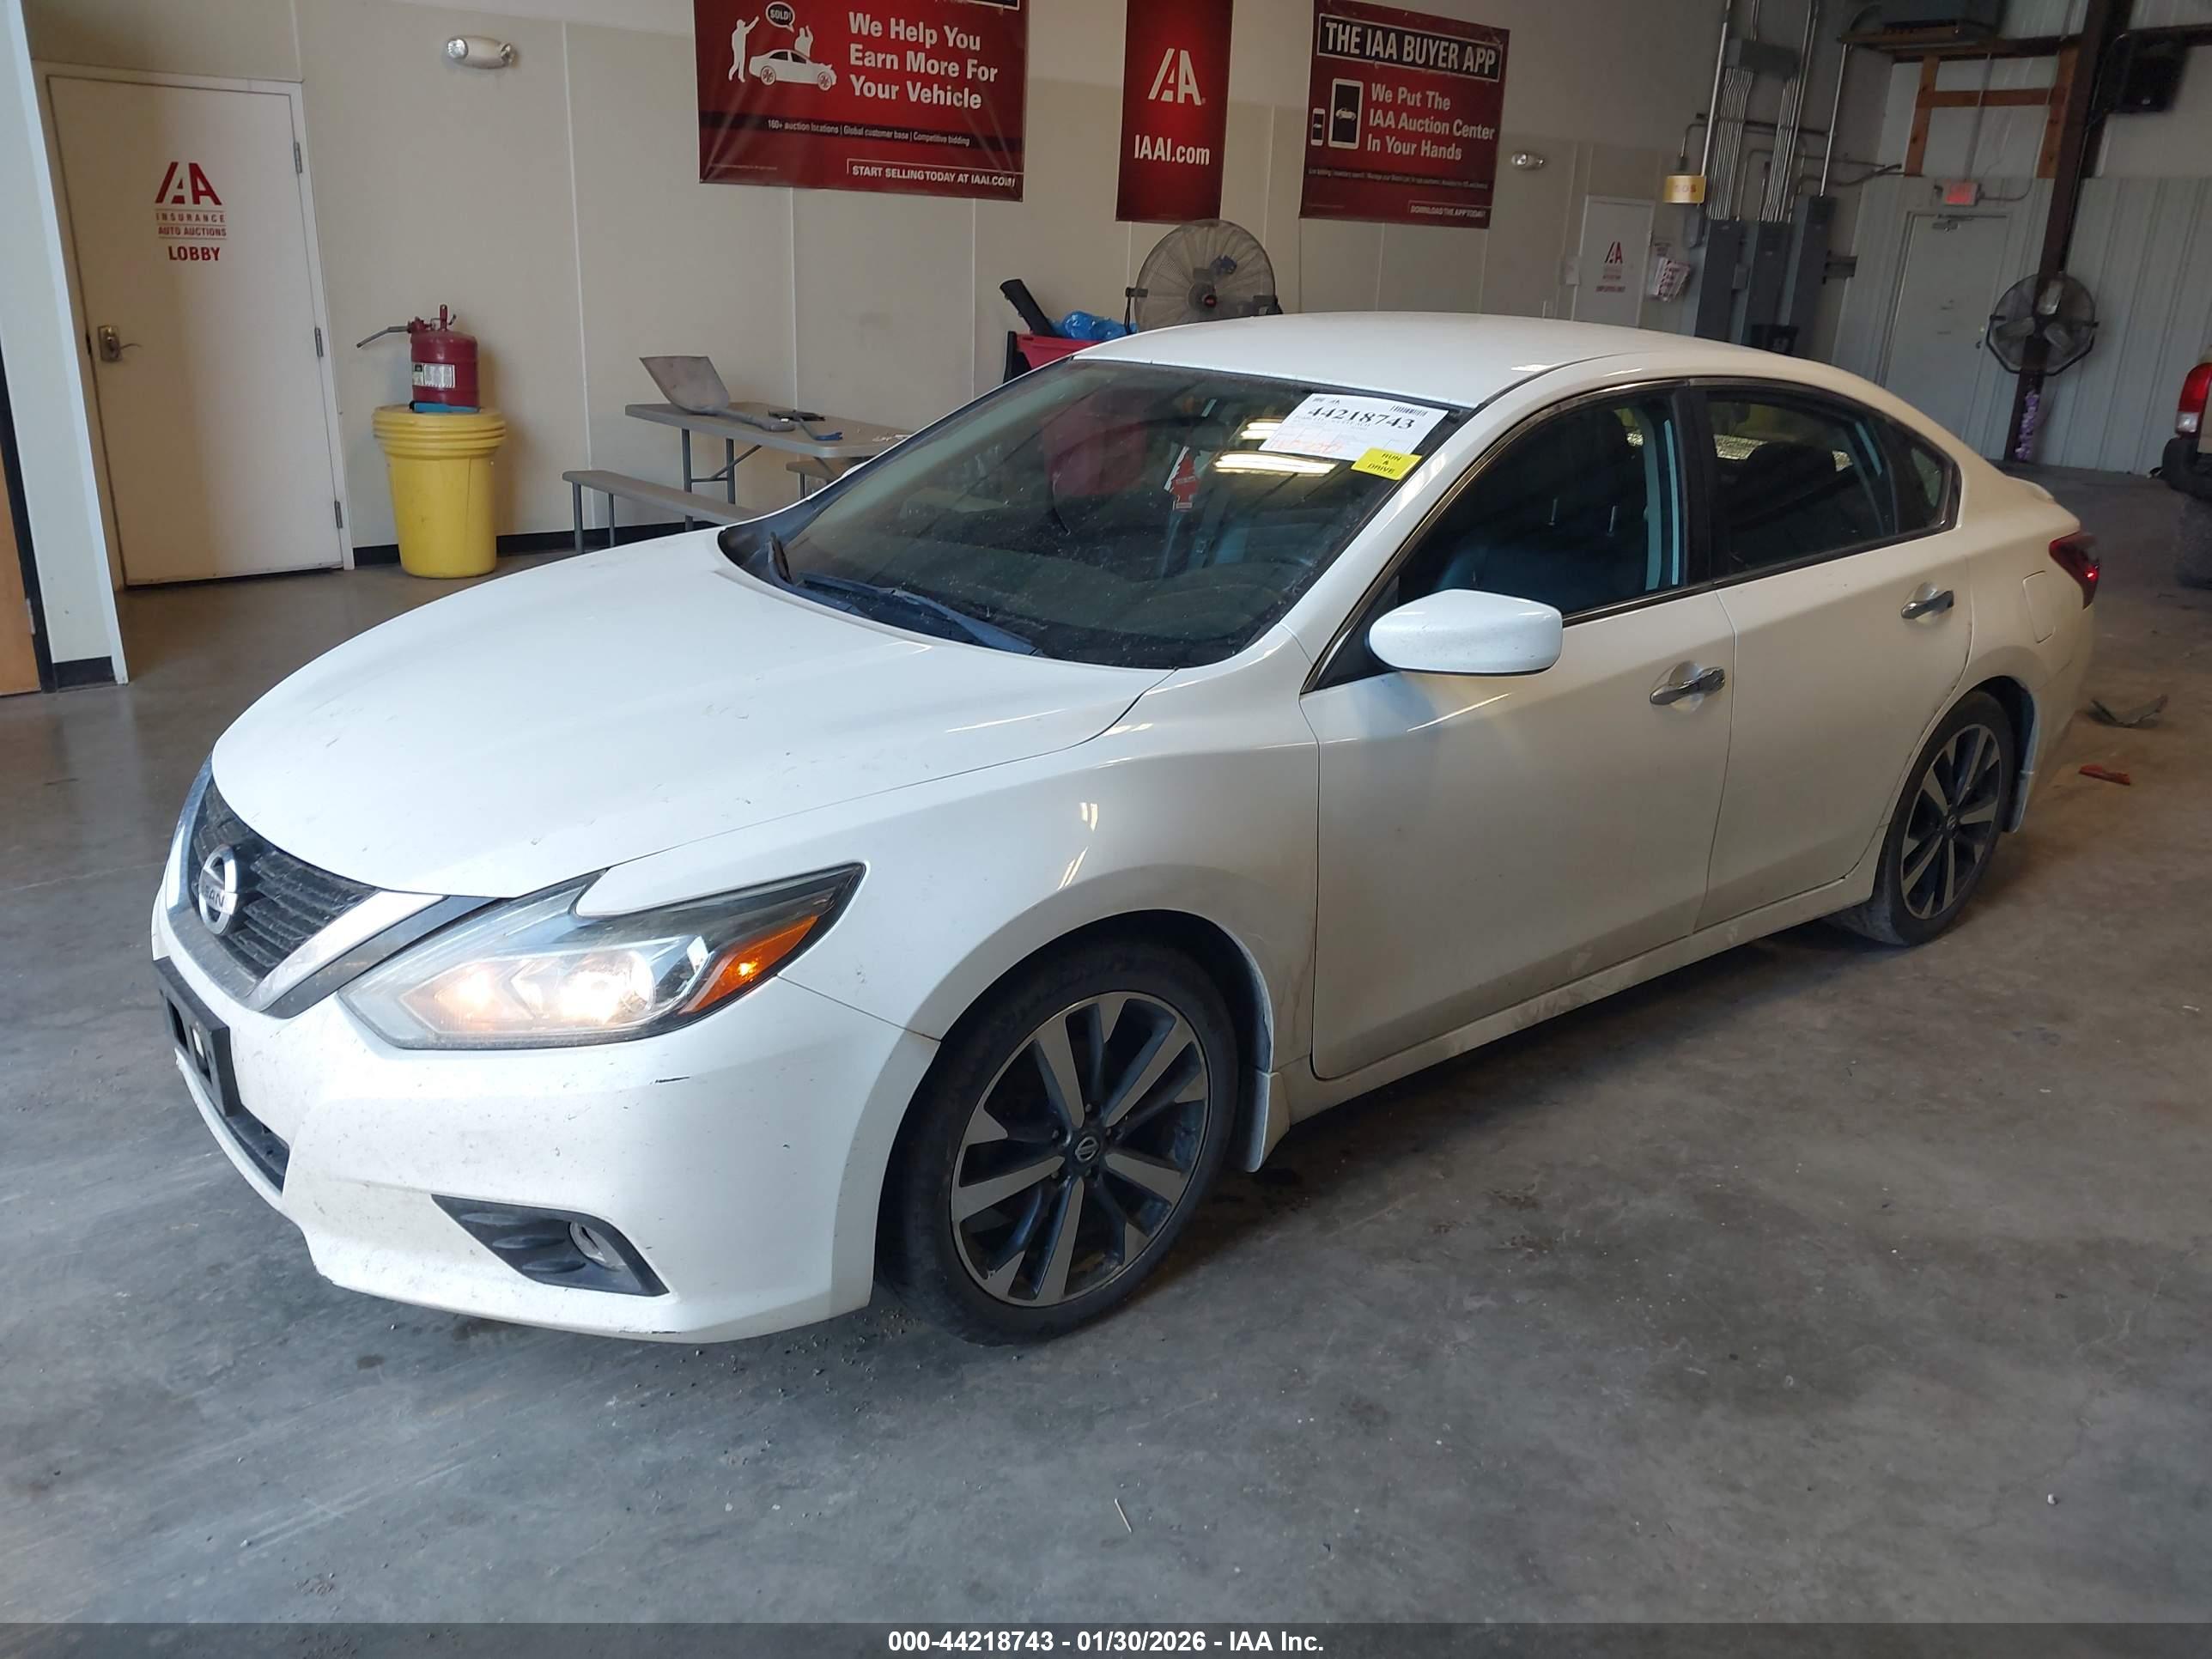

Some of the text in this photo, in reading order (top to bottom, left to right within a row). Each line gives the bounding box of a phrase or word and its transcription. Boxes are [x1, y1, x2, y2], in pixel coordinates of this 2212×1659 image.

[848, 11, 981, 51] We Help You
[850, 43, 998, 82] Earn More For
[1326, 21, 1496, 75] THE IAA BUYER APP
[849, 74, 982, 109] Your Vehicle
[1371, 82, 1451, 111] We Put The
[1369, 108, 1495, 140] IAA Auction Center
[1133, 134, 1210, 166] IAAI.com
[1367, 133, 1462, 161] In Your Hands
[852, 165, 883, 177] START
[885, 167, 925, 180] SELLING
[925, 171, 955, 183] TODAY
[957, 173, 969, 185] AT
[155, 212, 225, 222] INSURANCE
[158, 226, 227, 237] AUTO AUCTIONS
[168, 246, 221, 261] LOBBY
[1308, 406, 1416, 429] 44218743
